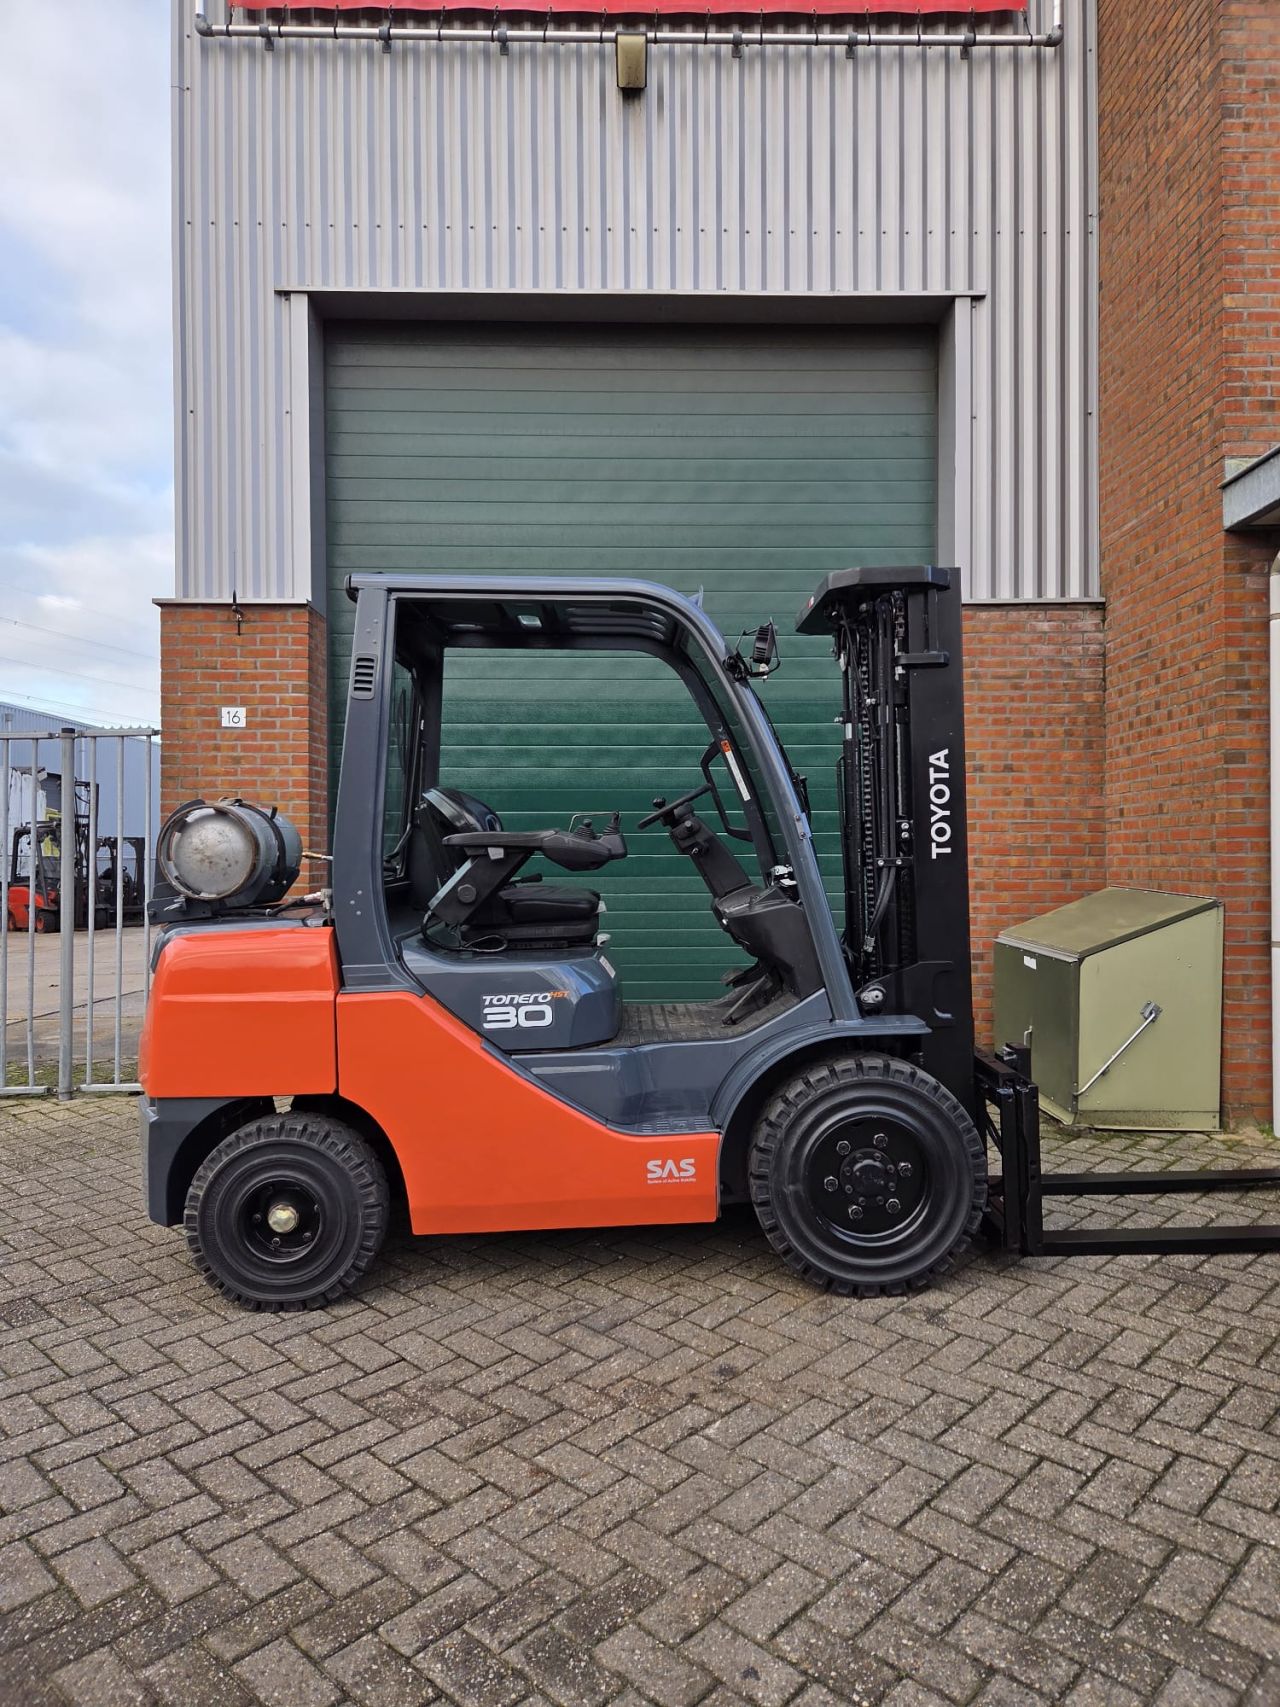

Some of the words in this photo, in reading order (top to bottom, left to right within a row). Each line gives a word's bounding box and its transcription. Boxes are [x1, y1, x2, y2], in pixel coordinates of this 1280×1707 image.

[227, 710, 241, 725] 16
[929, 749, 952, 859] TOYOTA
[482, 1004, 553, 1029] 30
[647, 1158, 696, 1178] SAS
